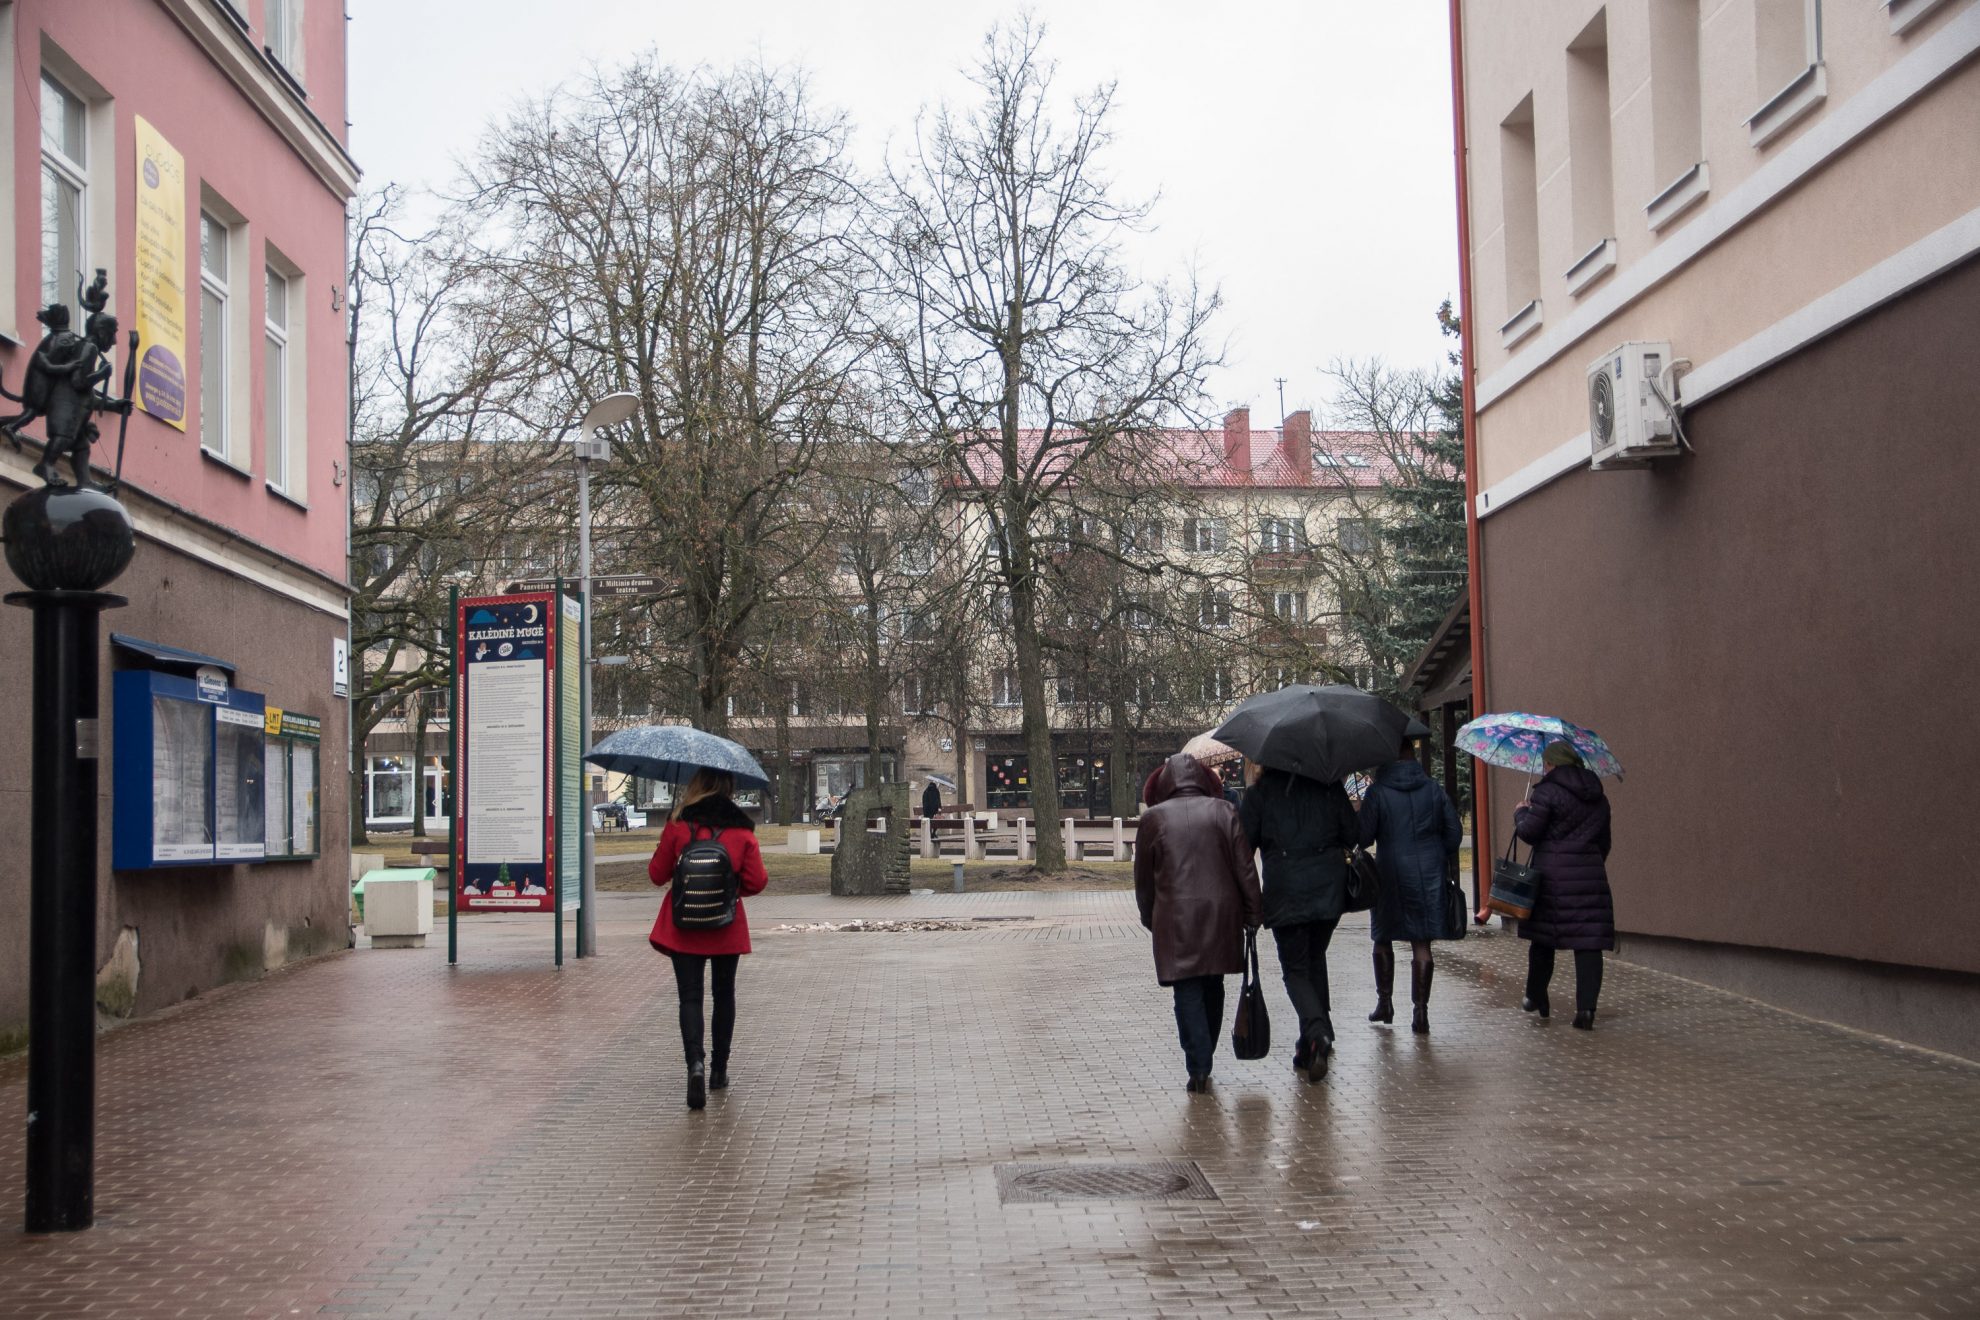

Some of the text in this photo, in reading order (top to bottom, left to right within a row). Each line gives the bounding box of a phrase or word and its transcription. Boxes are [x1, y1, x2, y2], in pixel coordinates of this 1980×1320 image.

[519, 583, 550, 591] Panevėžio
[605, 579, 630, 587] Miltinio
[468, 623, 544, 641] KALĖDINĖ MUGĖ
[338, 649, 343, 673] 2
